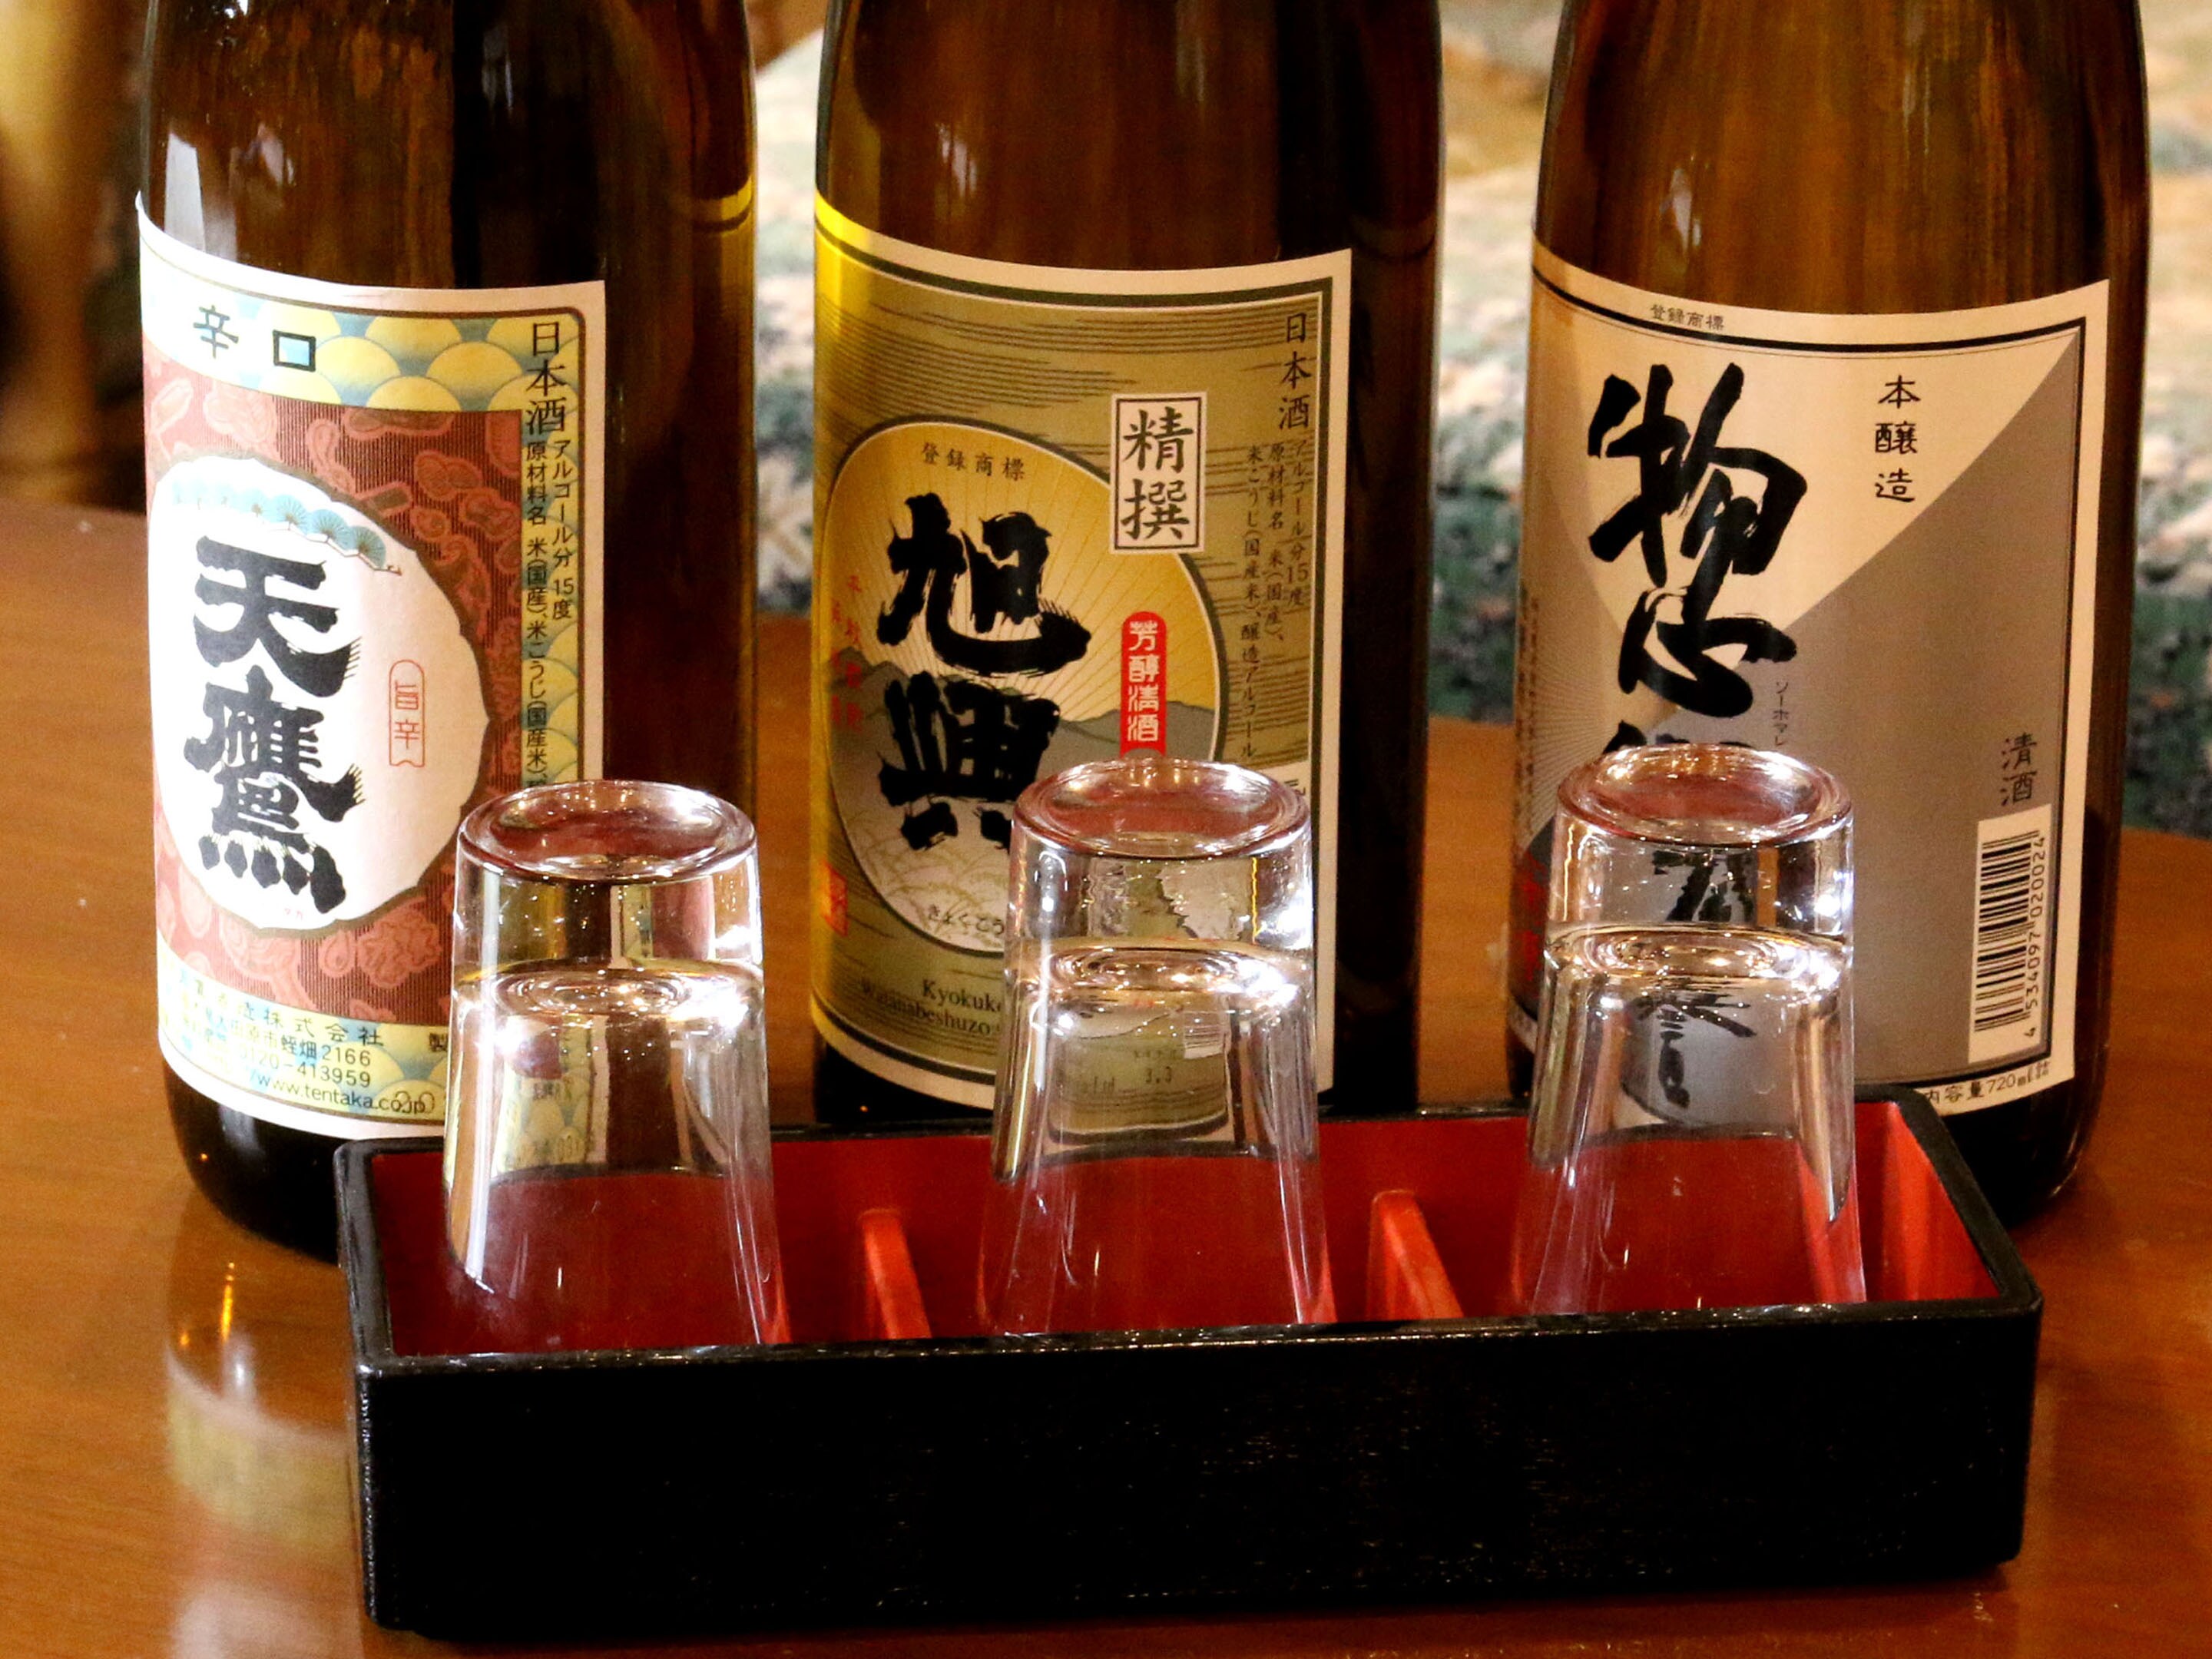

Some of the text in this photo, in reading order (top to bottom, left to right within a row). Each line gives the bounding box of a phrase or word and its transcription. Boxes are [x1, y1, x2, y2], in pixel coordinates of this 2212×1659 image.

[194, 305, 316, 372] 辛口
[528, 320, 567, 435] 日本酒
[1278, 313, 1310, 430] 日本酒
[526, 442, 548, 525] 原材料名
[922, 442, 1025, 482] 登録商標
[1121, 406, 1194, 541] 精撰
[1269, 442, 1285, 530] 原材料名
[1875, 375, 1921, 502] 本醸造
[1588, 363, 1807, 750] 惣
[184, 535, 366, 914] 天鷹
[394, 680, 419, 750] 旨辛
[2002, 732, 2038, 806] 清酒
[2025, 836, 2046, 1038] 4 534097 020024
